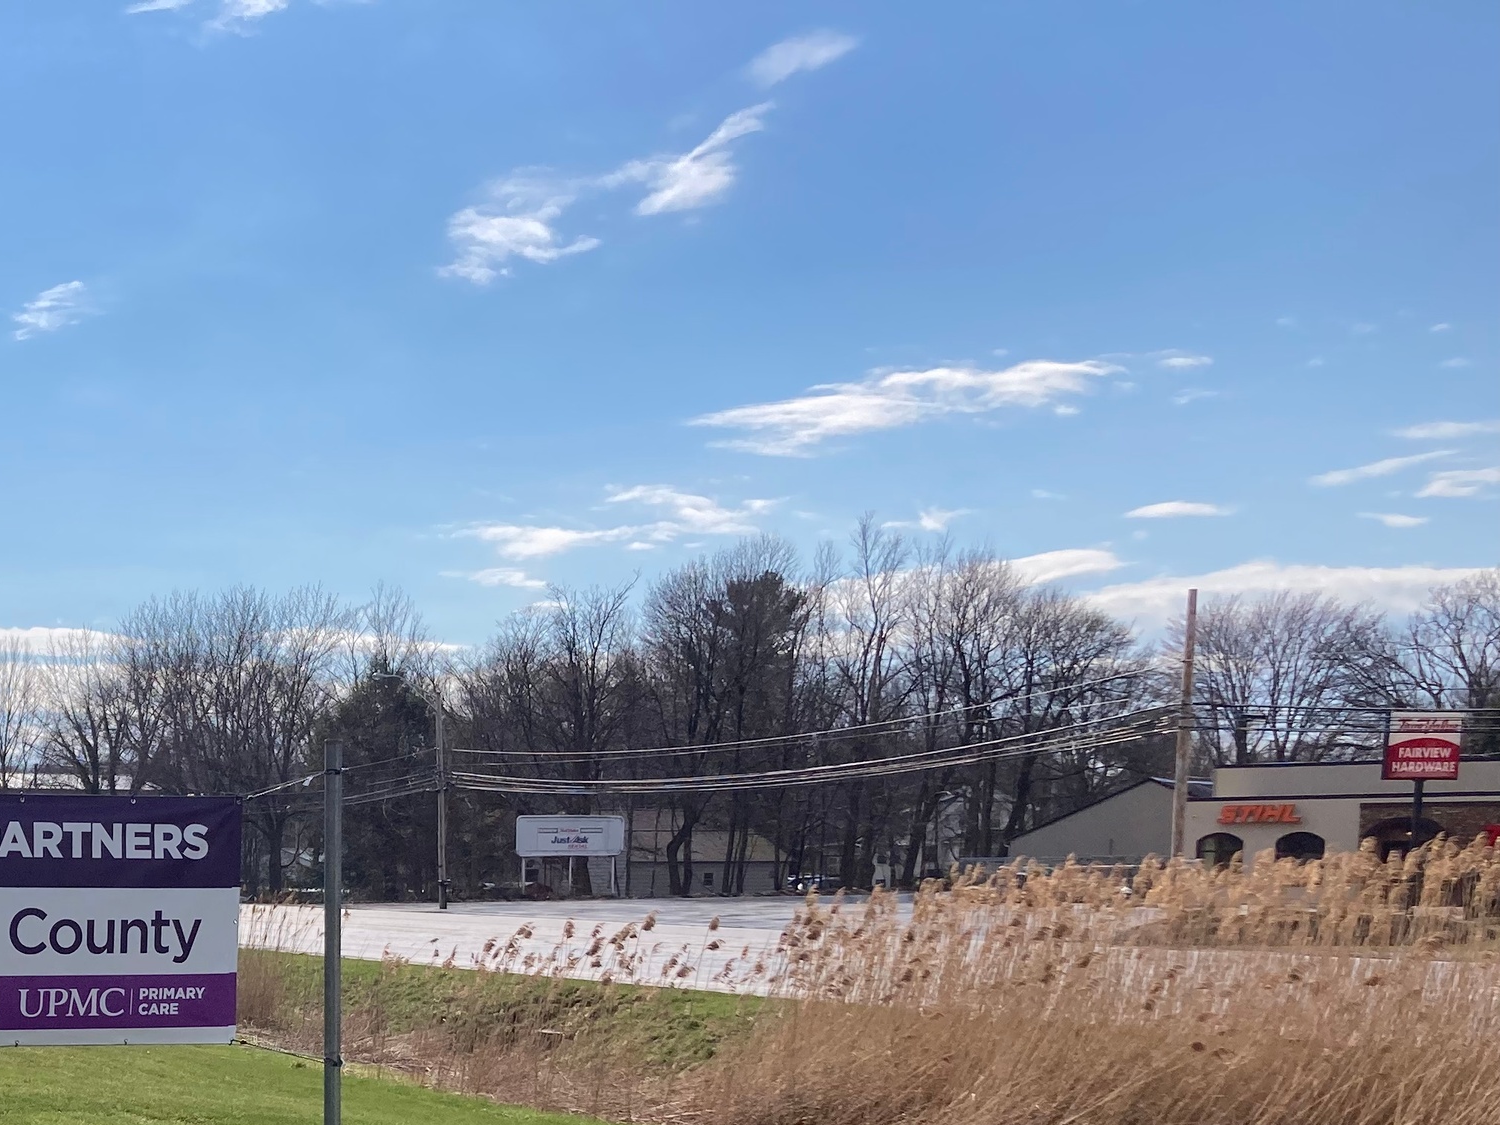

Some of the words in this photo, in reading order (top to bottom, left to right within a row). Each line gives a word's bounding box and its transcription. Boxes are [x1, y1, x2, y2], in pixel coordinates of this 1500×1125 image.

[1398, 747, 1452, 758] FAIRVIEW
[1391, 761, 1456, 772] HARDWARE
[1217, 804, 1302, 824] STIHL
[551, 836, 570, 844] Just
[9, 907, 202, 964] County
[139, 986, 206, 1002] PRIMARY
[18, 987, 127, 1018] UPMC
[138, 1002, 180, 1016] CARE
